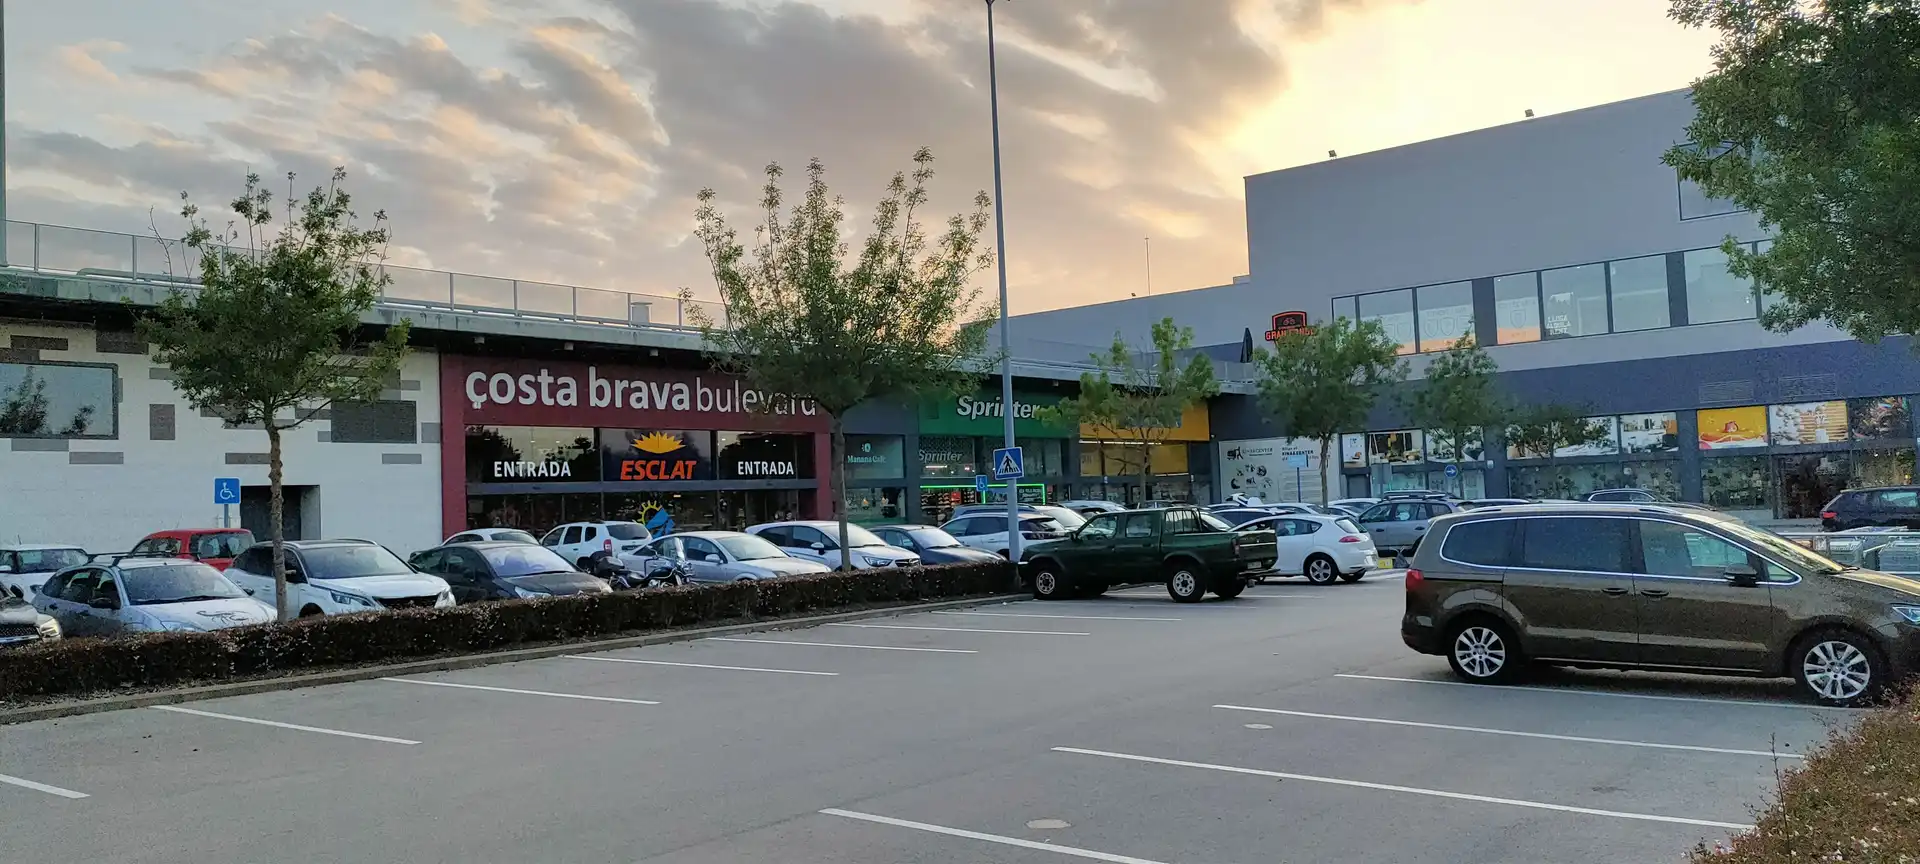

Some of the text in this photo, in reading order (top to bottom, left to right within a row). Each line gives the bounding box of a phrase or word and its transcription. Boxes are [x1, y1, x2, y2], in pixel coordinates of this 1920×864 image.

[589, 366, 690, 411] brava
[918, 449, 963, 463] Sprinter
[493, 461, 572, 478] ENTRADA
[620, 460, 697, 480] ESCLAT
[737, 461, 795, 475] ENTRADA
